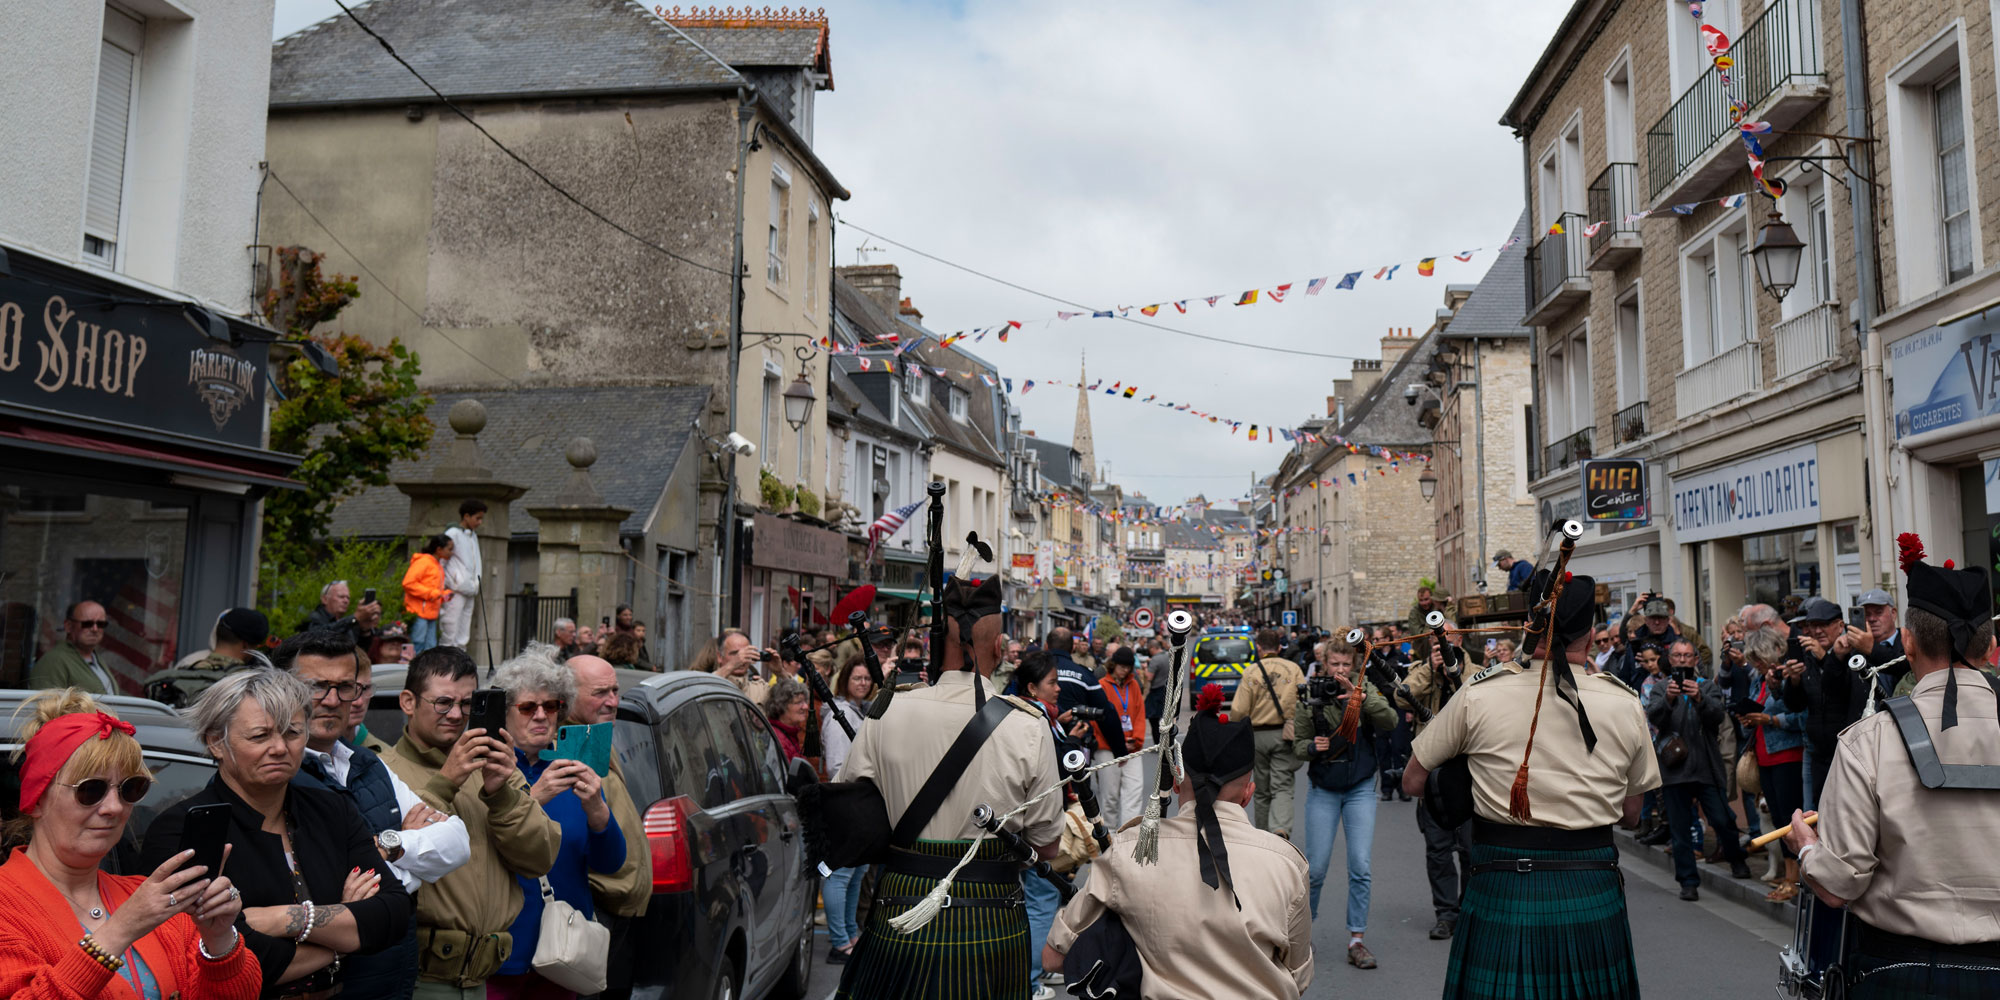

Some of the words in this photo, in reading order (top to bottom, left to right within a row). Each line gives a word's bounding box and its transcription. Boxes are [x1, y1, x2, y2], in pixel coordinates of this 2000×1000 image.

[1913, 402, 1962, 430] CIGARETTES
[1589, 467, 1638, 490] HIFI
[1591, 491, 1640, 509] Center
[1675, 481, 1731, 531] CARENTAN
[1736, 459, 1818, 520] SOLIDARITE
